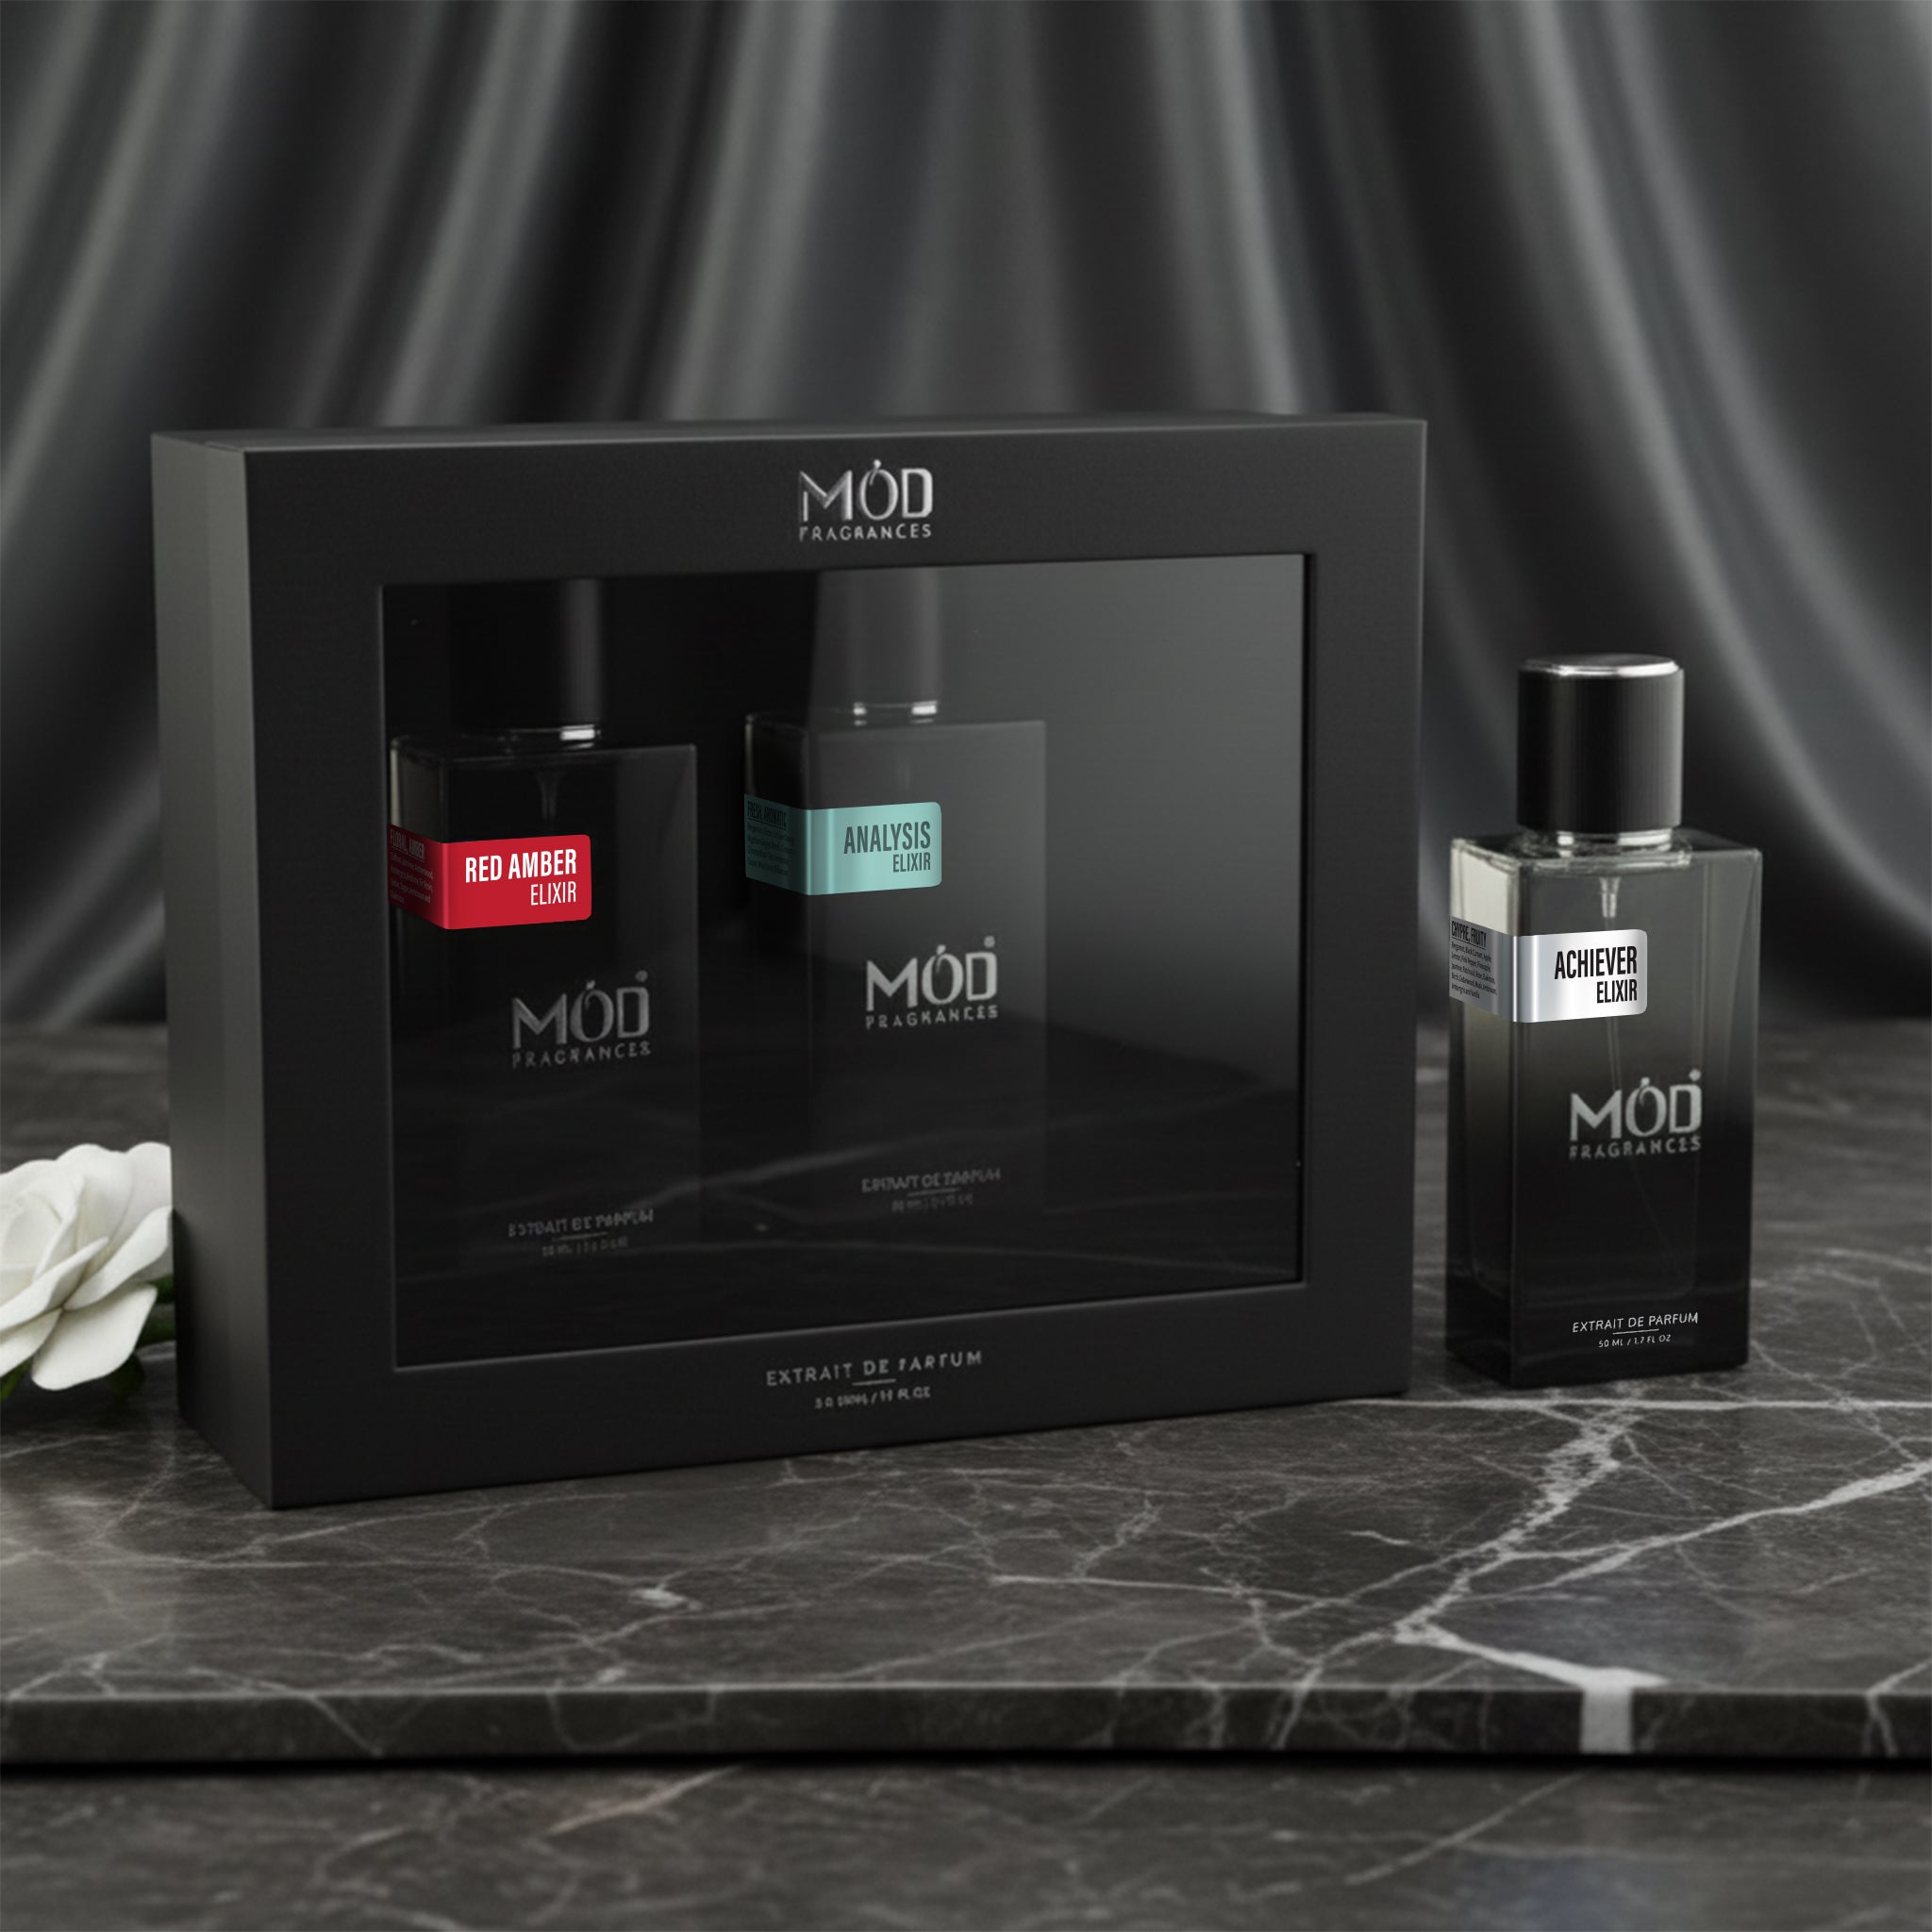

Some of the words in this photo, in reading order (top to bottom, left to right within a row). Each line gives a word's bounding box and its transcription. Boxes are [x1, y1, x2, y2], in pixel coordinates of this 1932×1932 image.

[799, 523, 932, 542] FRAGRANCES
[843, 821, 931, 855] ANALYSIS
[465, 855, 503, 884] RED
[508, 848, 577, 880] AMBER
[892, 852, 931, 874] ELIXIR
[530, 880, 577, 907] ELIXIR
[1554, 945, 1638, 980] ACHIEVER
[1596, 978, 1638, 1005] ELIXIR
[1572, 1317, 1624, 1333] EXTRAIT
[1628, 1316, 1644, 1328] DE
[1648, 1311, 1699, 1326] PARFUM
[1598, 1339, 1609, 1348] 50
[1634, 1336, 1645, 1345] 1.7
[1647, 1335, 1656, 1343] FL
[1658, 1333, 1672, 1342] OZ
[766, 1362, 853, 1387] EXTRAIT
[862, 1358, 890, 1376] DE
